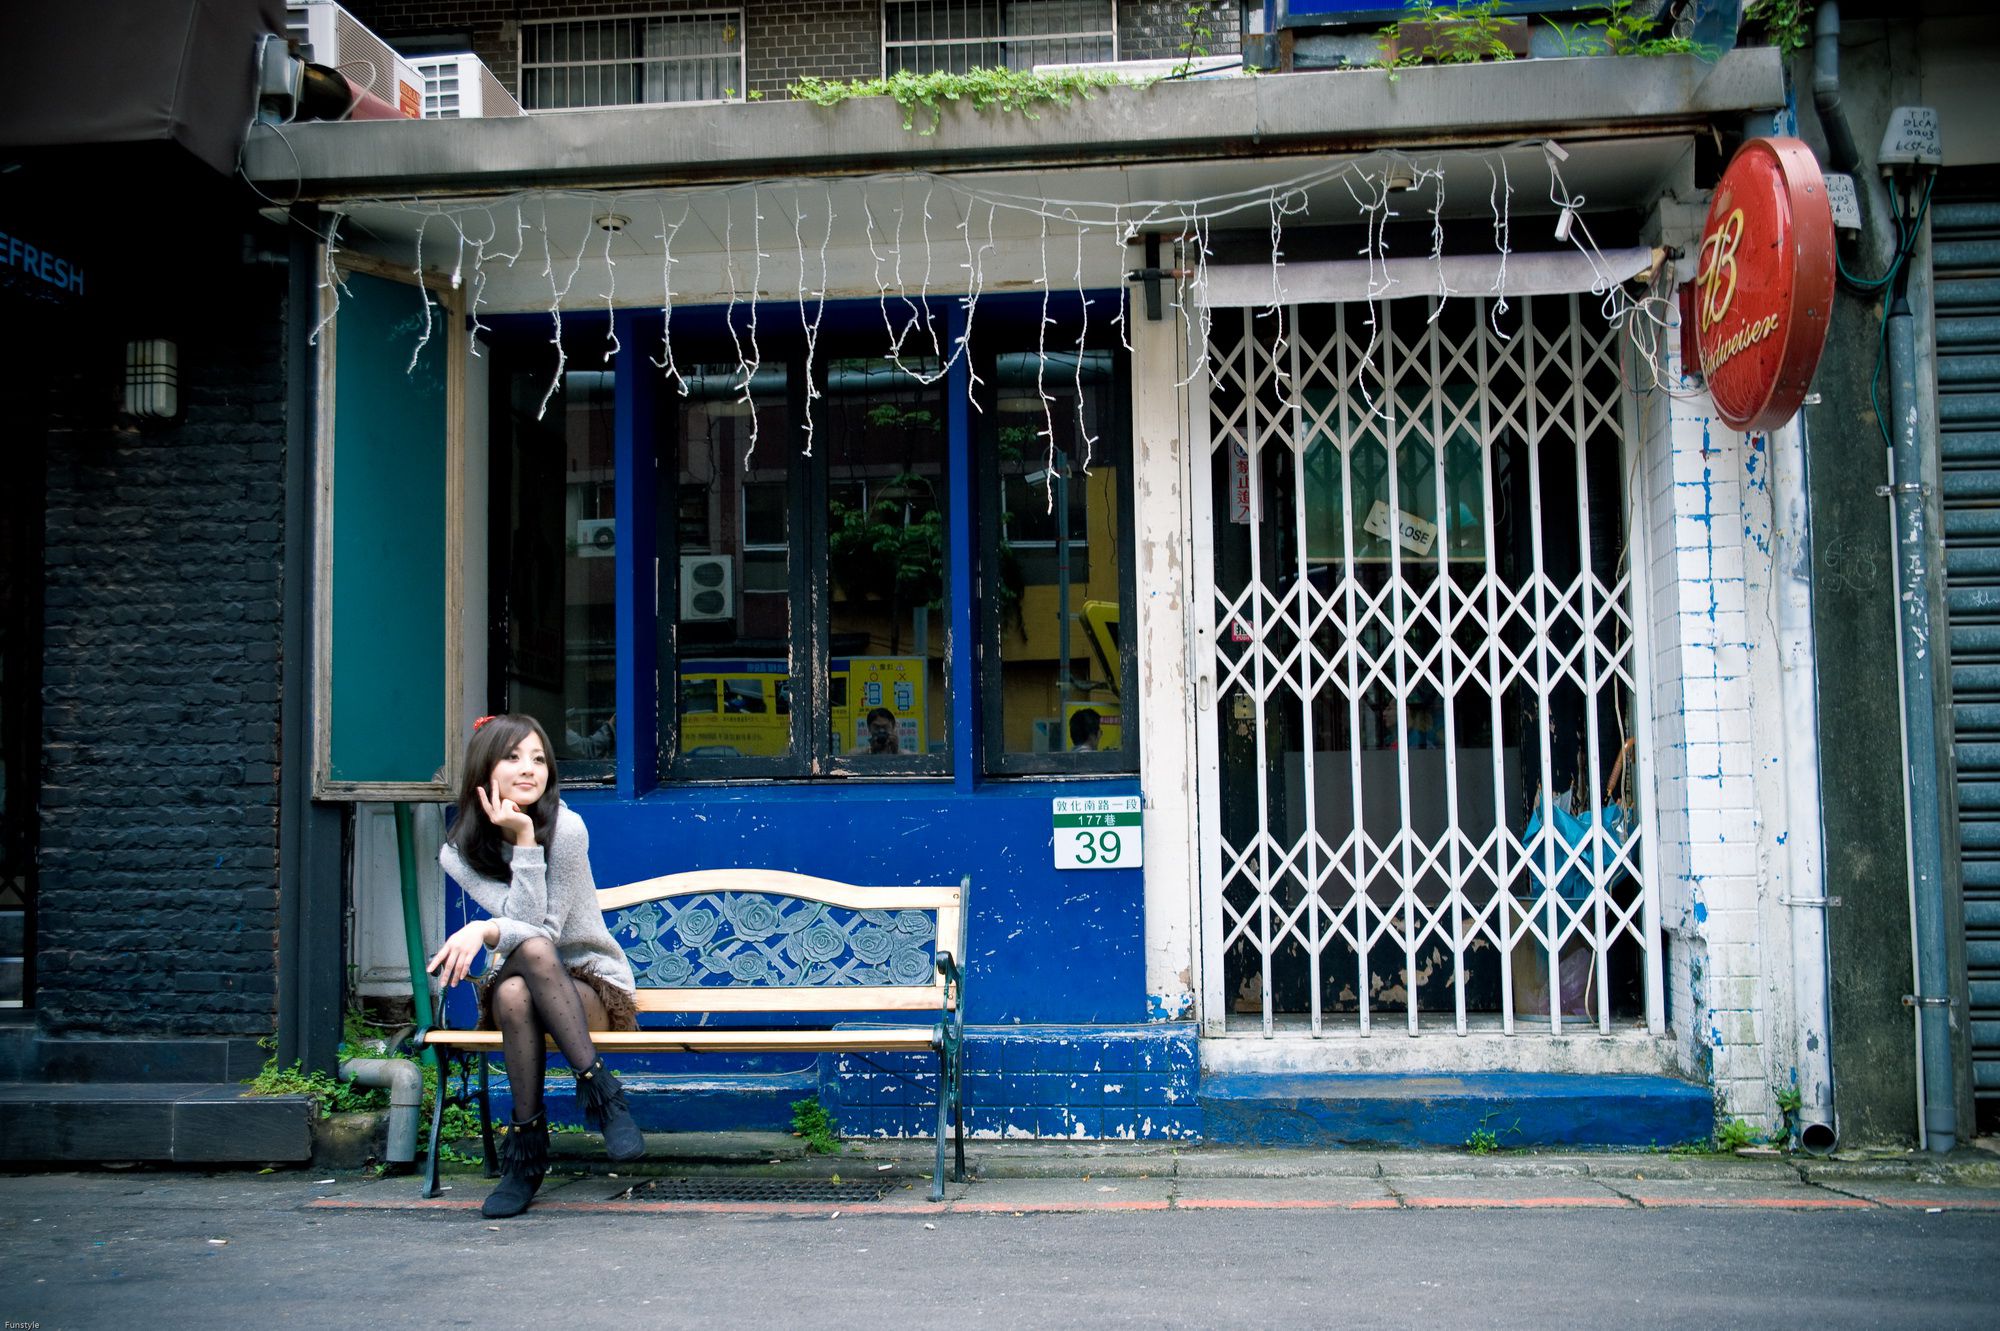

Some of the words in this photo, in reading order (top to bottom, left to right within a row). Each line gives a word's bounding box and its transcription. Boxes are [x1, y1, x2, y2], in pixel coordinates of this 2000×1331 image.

[0, 231, 84, 296] EFRESH
[1700, 313, 1779, 377] Budweiser
[1396, 520, 1430, 545] LOSE
[1057, 799, 1137, 812] 敦化南路一段
[1078, 813, 1116, 826] 177巷
[1075, 830, 1122, 864] 39
